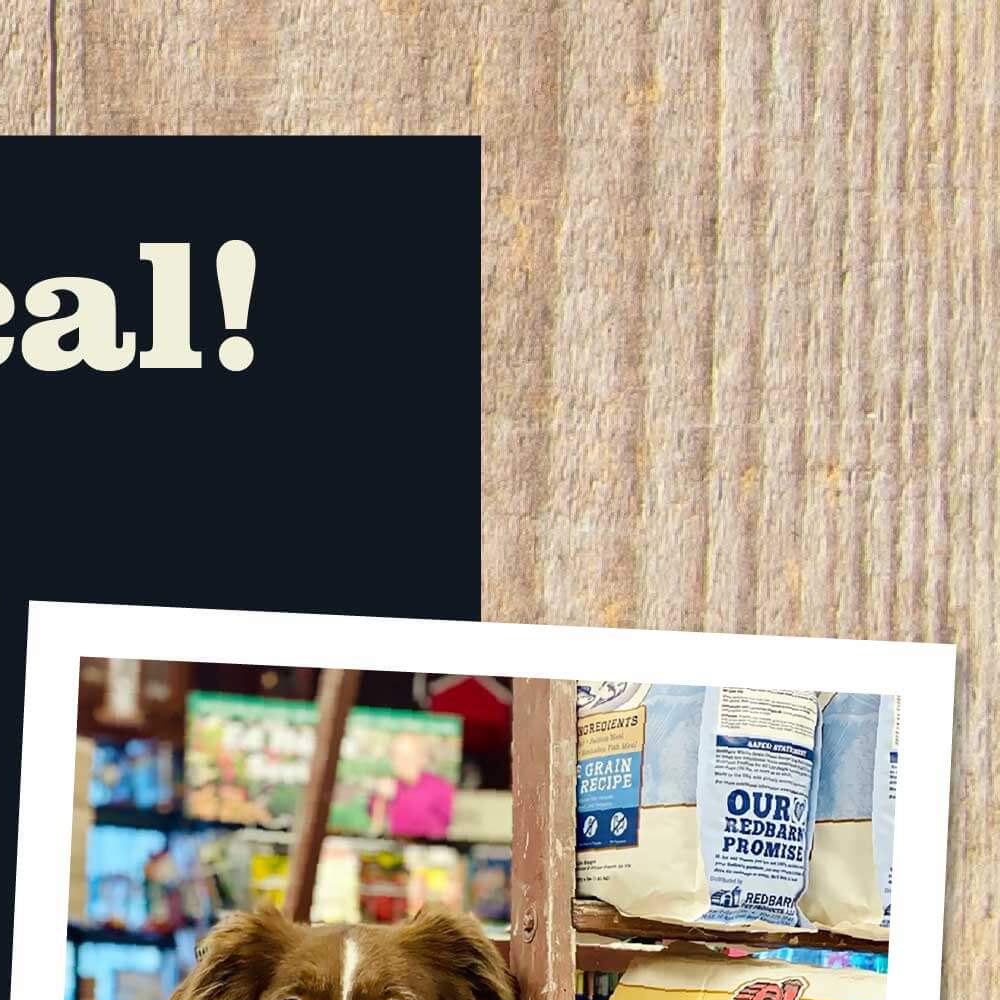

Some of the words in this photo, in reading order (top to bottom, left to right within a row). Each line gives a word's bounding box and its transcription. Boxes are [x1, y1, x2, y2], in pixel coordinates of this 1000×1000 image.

[585, 757, 632, 777] GRAIN
[580, 774, 632, 793] RECIPE
[727, 789, 791, 822] OUR
[722, 836, 803, 862] PROMISE
